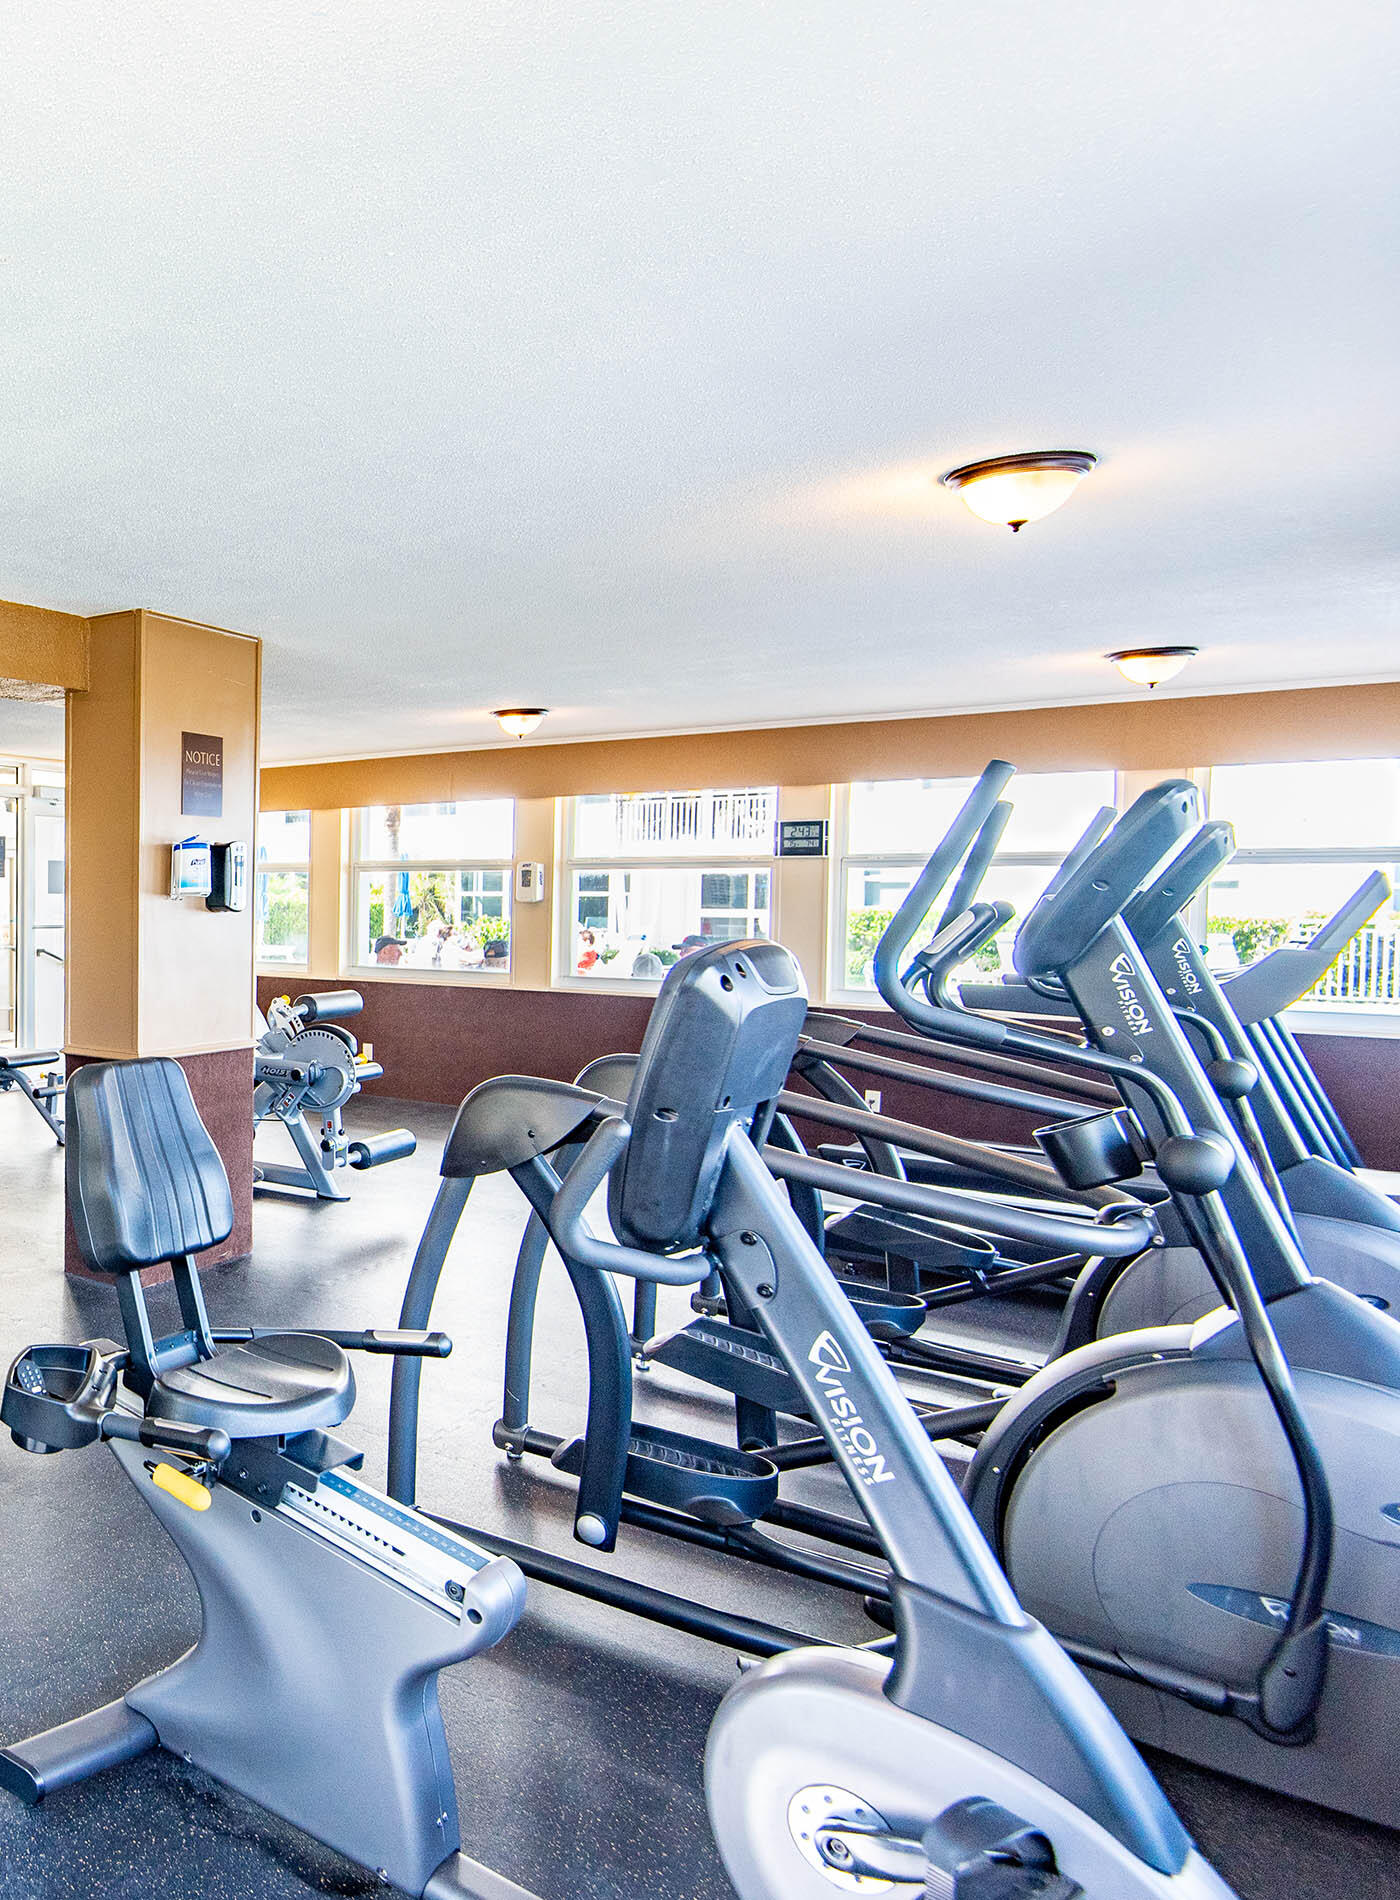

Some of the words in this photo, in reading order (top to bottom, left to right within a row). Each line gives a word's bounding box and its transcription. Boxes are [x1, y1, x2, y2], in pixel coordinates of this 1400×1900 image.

[185, 750, 221, 767] NOTICE
[1111, 972, 1154, 1034] VISION
[1173, 950, 1203, 994] VISION
[815, 1367, 897, 1484] VISION
[830, 1417, 876, 1486] FITNESS
